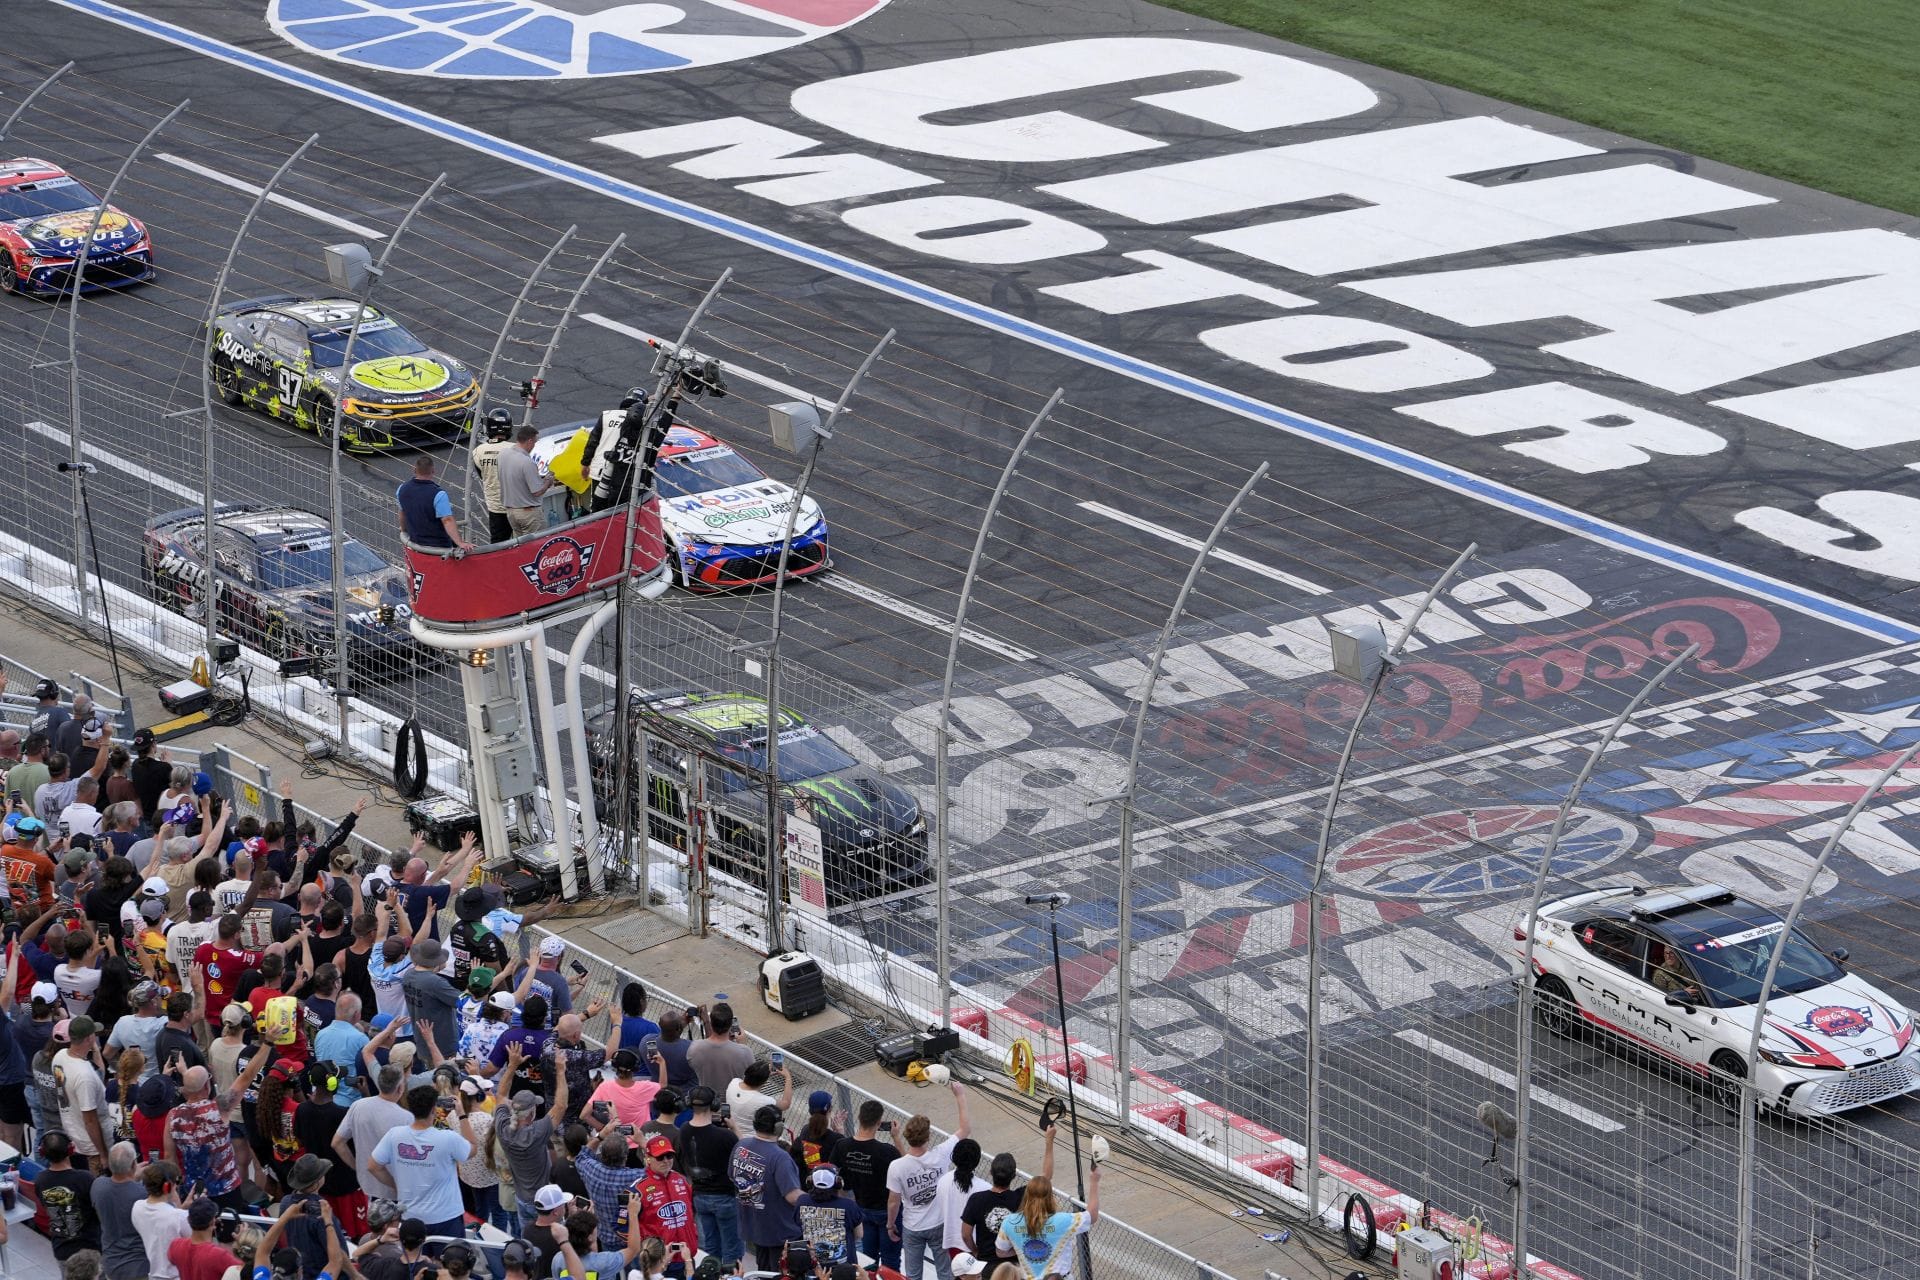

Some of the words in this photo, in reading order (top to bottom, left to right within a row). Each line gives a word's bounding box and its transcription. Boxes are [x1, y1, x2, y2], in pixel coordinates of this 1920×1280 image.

[789, 37, 1920, 451] CHA
[590, 116, 1729, 474] MOTOR
[279, 368, 303, 408] 97
[616, 449, 634, 464] 12
[672, 489, 755, 514] Mobil
[755, 542, 799, 556] CAMY
[540, 547, 575, 571] Coca-Cola
[546, 563, 574, 581] 600
[820, 568, 1594, 773] CHARLOT
[9, 860, 36, 884] 11
[177, 935, 204, 947] TRAIN
[176, 947, 196, 957] HAR
[181, 958, 192, 967] TR
[209, 965, 219, 976] hp
[1577, 975, 1703, 1044] CAMRY
[1813, 1008, 1851, 1025] Coca-Cola
[1590, 996, 1631, 1025] OFFICIAL
[1634, 1020, 1657, 1038] PACE
[1662, 1035, 1681, 1051] CAR
[515, 1067, 543, 1081] edEx
[1848, 1060, 1897, 1078] CAMRY
[732, 1158, 764, 1177] ELLIOTT
[906, 1167, 944, 1189] BUSCH
